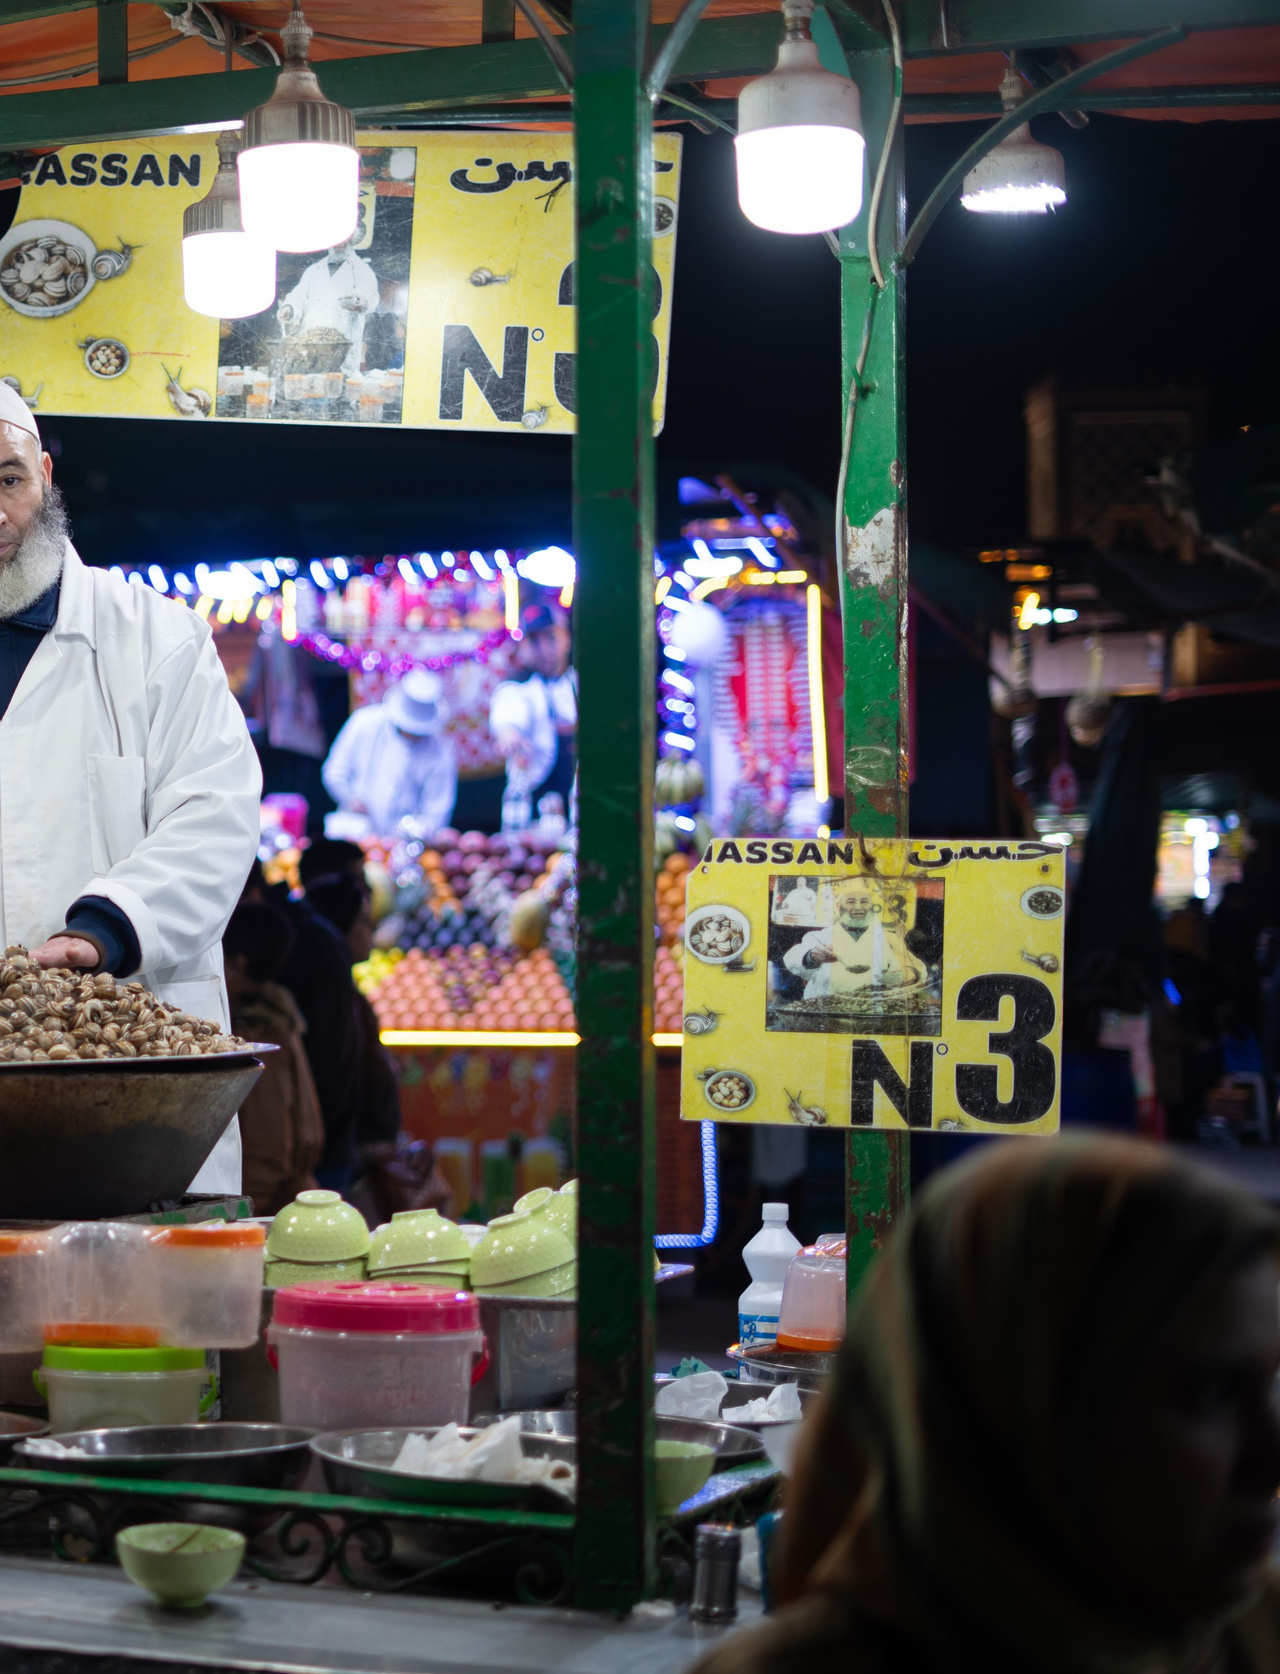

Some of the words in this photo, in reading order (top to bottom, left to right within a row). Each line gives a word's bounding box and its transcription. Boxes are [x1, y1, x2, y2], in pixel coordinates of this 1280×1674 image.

[22, 153, 201, 187] ASSAN
[450, 157, 675, 194] سن
[907, 842, 1063, 868] حسن
